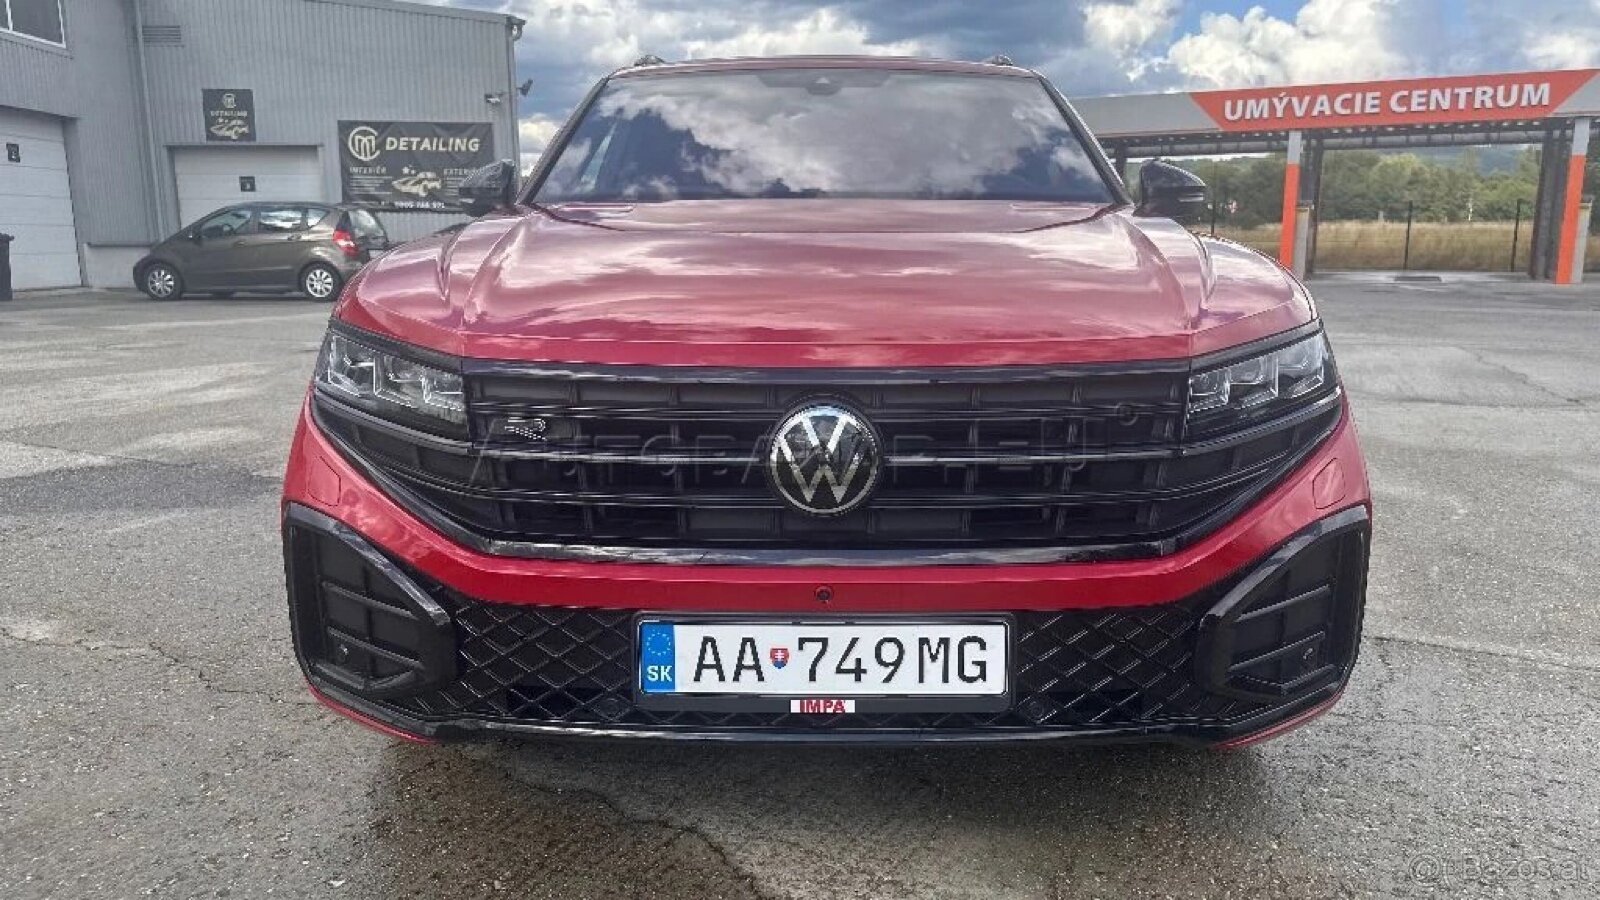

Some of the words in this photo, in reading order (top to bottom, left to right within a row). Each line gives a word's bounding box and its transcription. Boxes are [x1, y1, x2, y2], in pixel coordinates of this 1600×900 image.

[1224, 91, 1381, 121] UMÝVACIE
[1389, 82, 1551, 113] CENTRUM
[386, 136, 481, 153] DETAILING
[693, 636, 765, 683] AA
[646, 665, 673, 682] SK
[799, 699, 846, 714] IMPA
